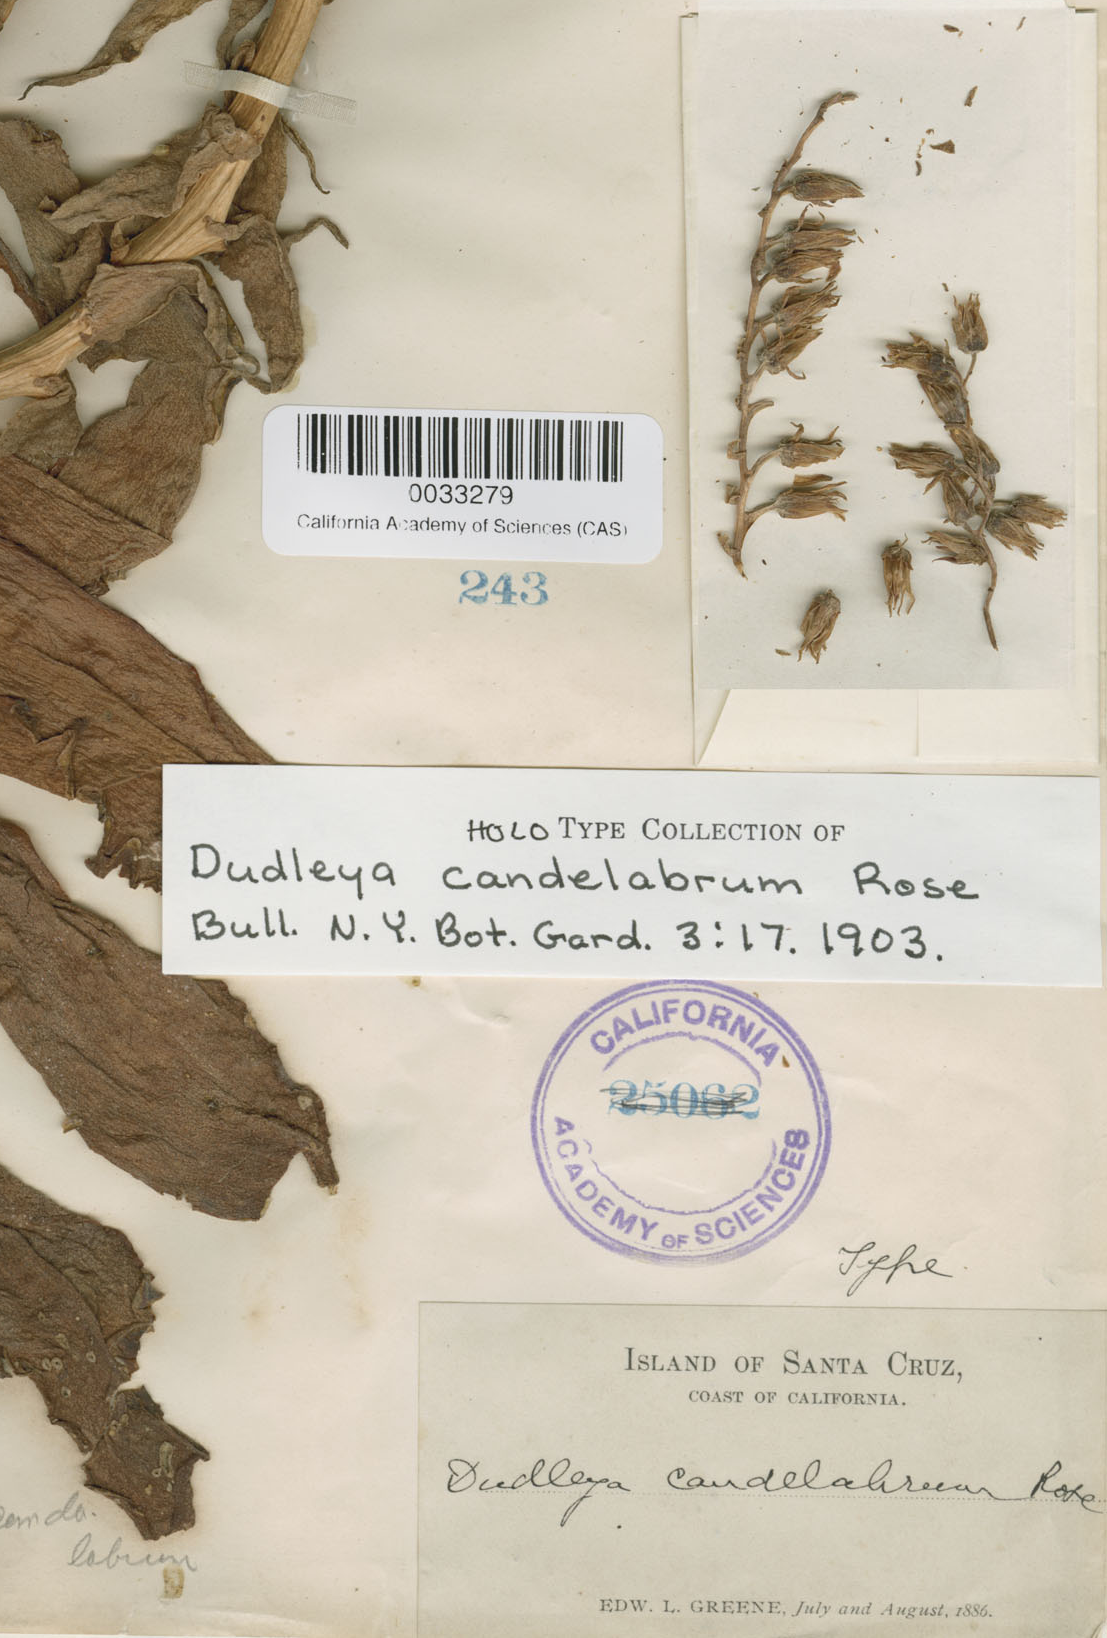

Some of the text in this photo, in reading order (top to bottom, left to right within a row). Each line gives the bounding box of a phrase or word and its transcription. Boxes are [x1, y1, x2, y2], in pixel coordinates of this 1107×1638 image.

[408, 483, 514, 505] 0033279
[297, 513, 628, 538] California Academy of Sciences (CAS)
[458, 569, 549, 606] 243
[467, 819, 550, 842] HOLO
[190, 843, 980, 900] Dudleya candelabrum Rose
[192, 906, 298, 941] Bull.
[435, 912, 517, 948] Bot.
[533, 919, 651, 951] Gard.
[822, 922, 944, 962] 1903.
[589, 999, 781, 1067] CALIFORNIA
[553, 1116, 811, 1249] ACADEMY OF SCIENCES
[688, 1390, 907, 1407] COAST OF CALIFORNIA.
[447, 1458, 631, 1527] Dudleya
[599, 1598, 993, 1620] EDW. L. GREENE, July and August, 1886.
